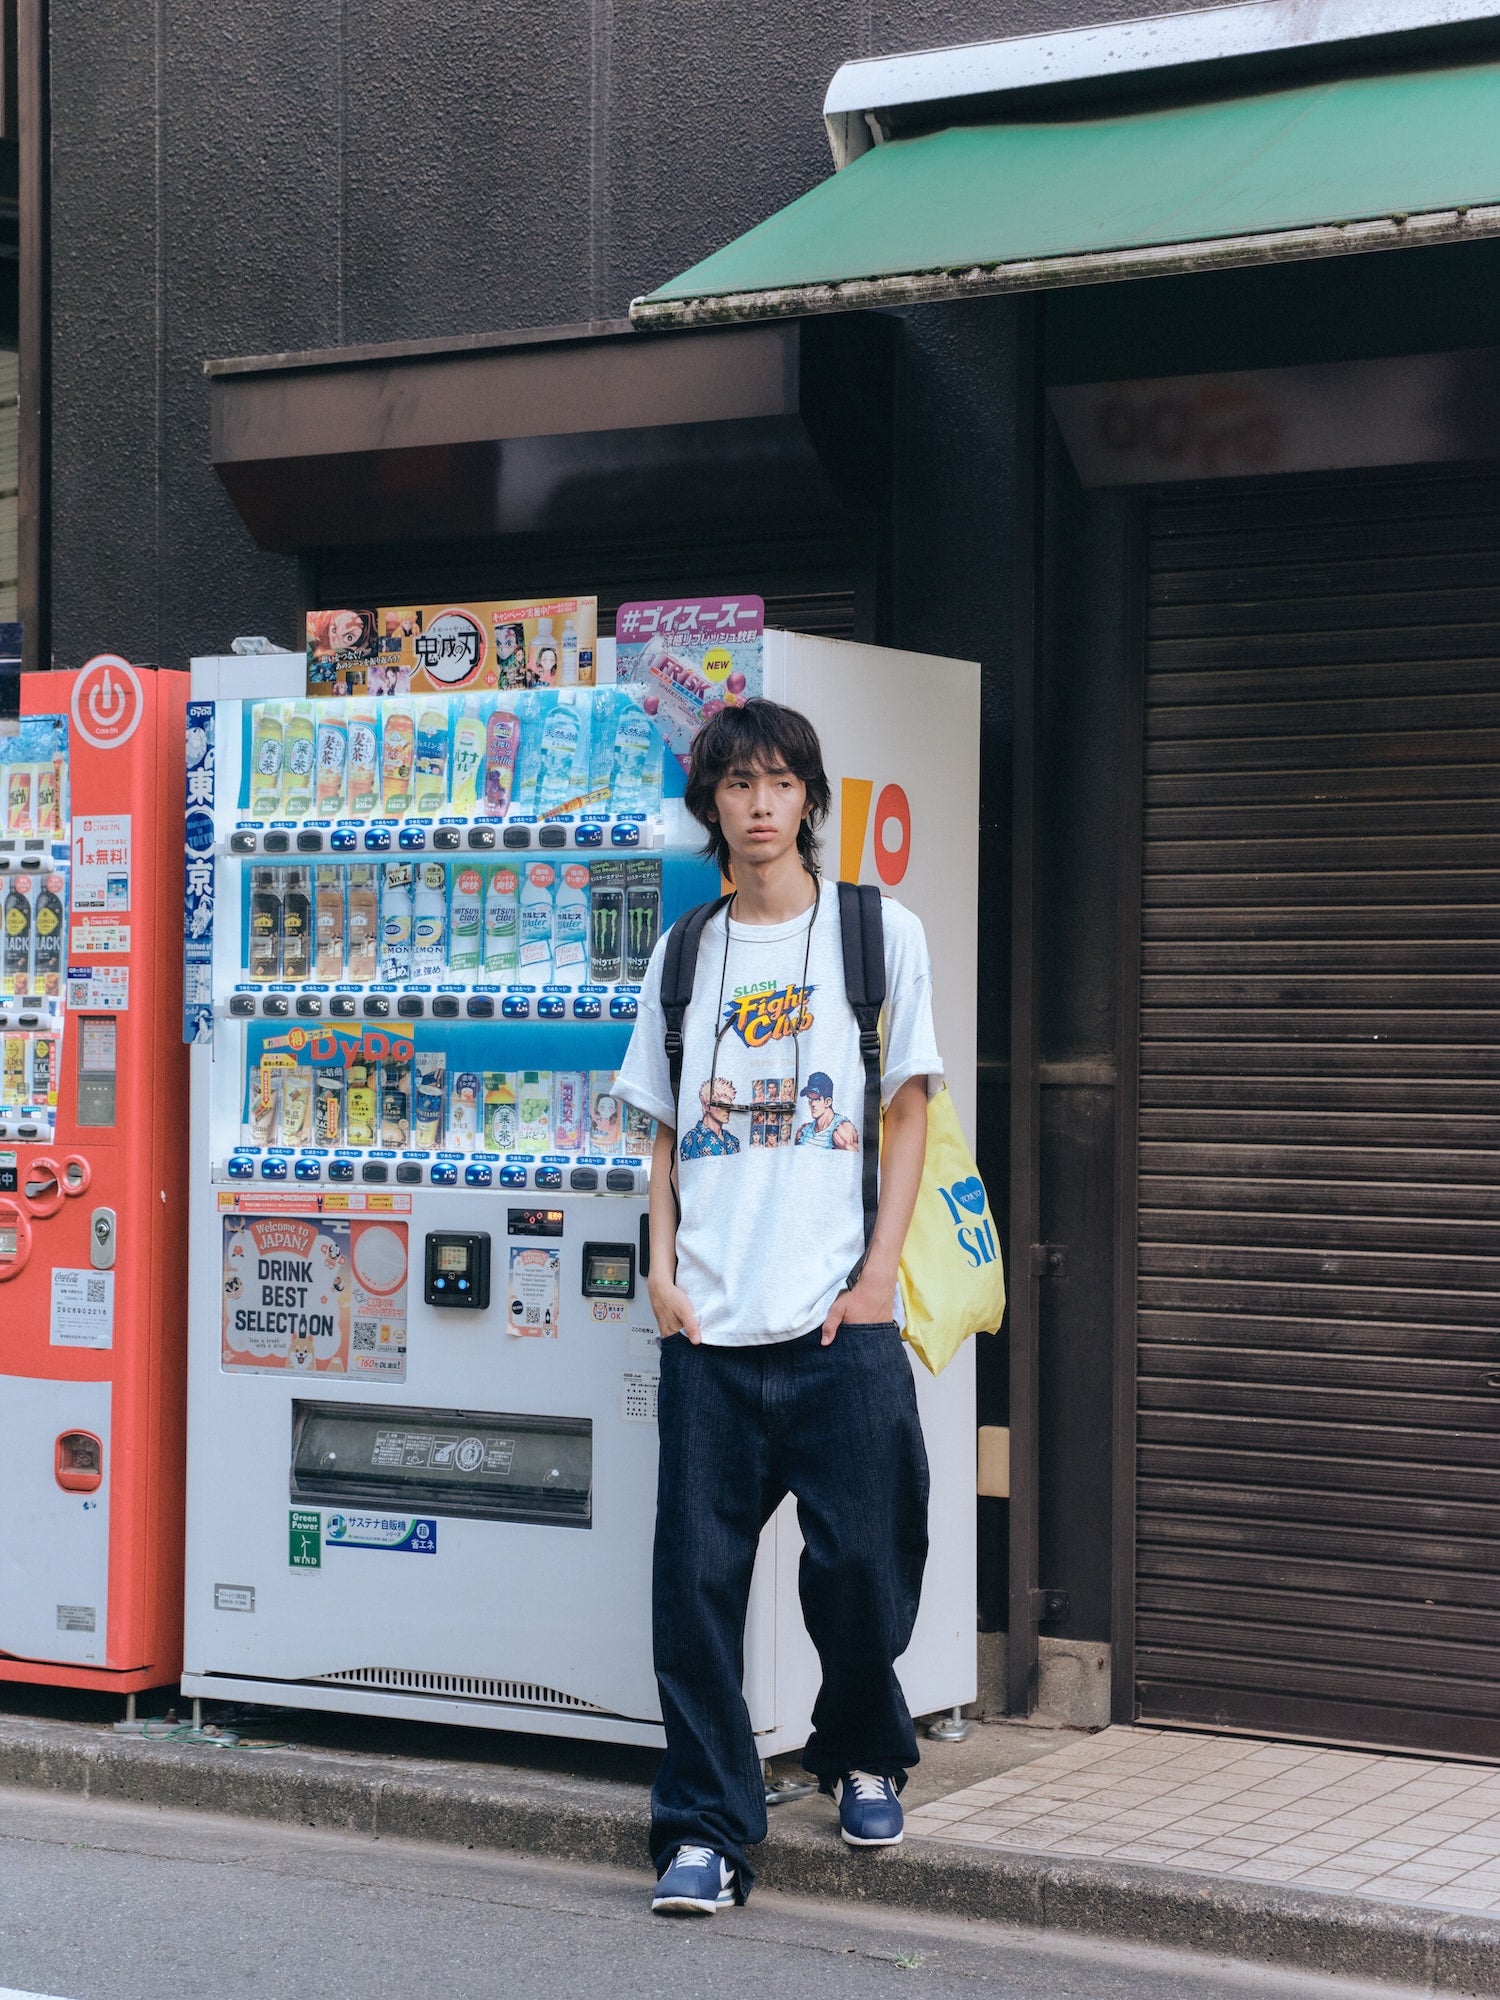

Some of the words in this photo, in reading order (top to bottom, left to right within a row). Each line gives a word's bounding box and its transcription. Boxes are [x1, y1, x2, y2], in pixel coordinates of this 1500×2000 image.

[622, 603, 758, 632] #ゴイスースー
[409, 632, 478, 677] 鬼滅の刃
[707, 661, 730, 670] NEW
[659, 656, 712, 700] FRISK
[190, 706, 212, 717] DyDo
[544, 728, 578, 742] 天然水
[618, 725, 650, 740] 天然水
[321, 735, 336, 765] 麦茶
[352, 733, 366, 762] 麦茶
[418, 742, 445, 751] ャスミン茶
[188, 832, 214, 847] TOKYO
[427, 876, 441, 884] No.1
[522, 918, 547, 928] Water
[557, 920, 582, 929] Water
[6, 936, 29, 951] LACK
[37, 936, 61, 951] LACK
[733, 979, 777, 998] SLASH
[734, 984, 810, 1031] Fight
[744, 1009, 814, 1048] Club
[311, 1033, 414, 1069] DyDo
[563, 1085, 572, 1124] FRISK
[499, 1112, 511, 1142] 葉の茶
[936, 1187, 965, 1227] I
[255, 1222, 296, 1234] Welcome
[298, 1226, 309, 1237] to
[260, 1234, 309, 1252] JAPAN!
[258, 1259, 313, 1283] DRINK
[262, 1285, 308, 1308] BEST
[235, 1309, 334, 1338] SELECTION
[611, 1312, 621, 1320] OK
[292, 1512, 318, 1523] Green
[348, 1516, 407, 1532] サステナ自販機
[291, 1521, 319, 1531] Power
[418, 1525, 427, 1537] 超
[411, 1539, 435, 1550] 省エネ
[293, 1555, 317, 1565] WIND
